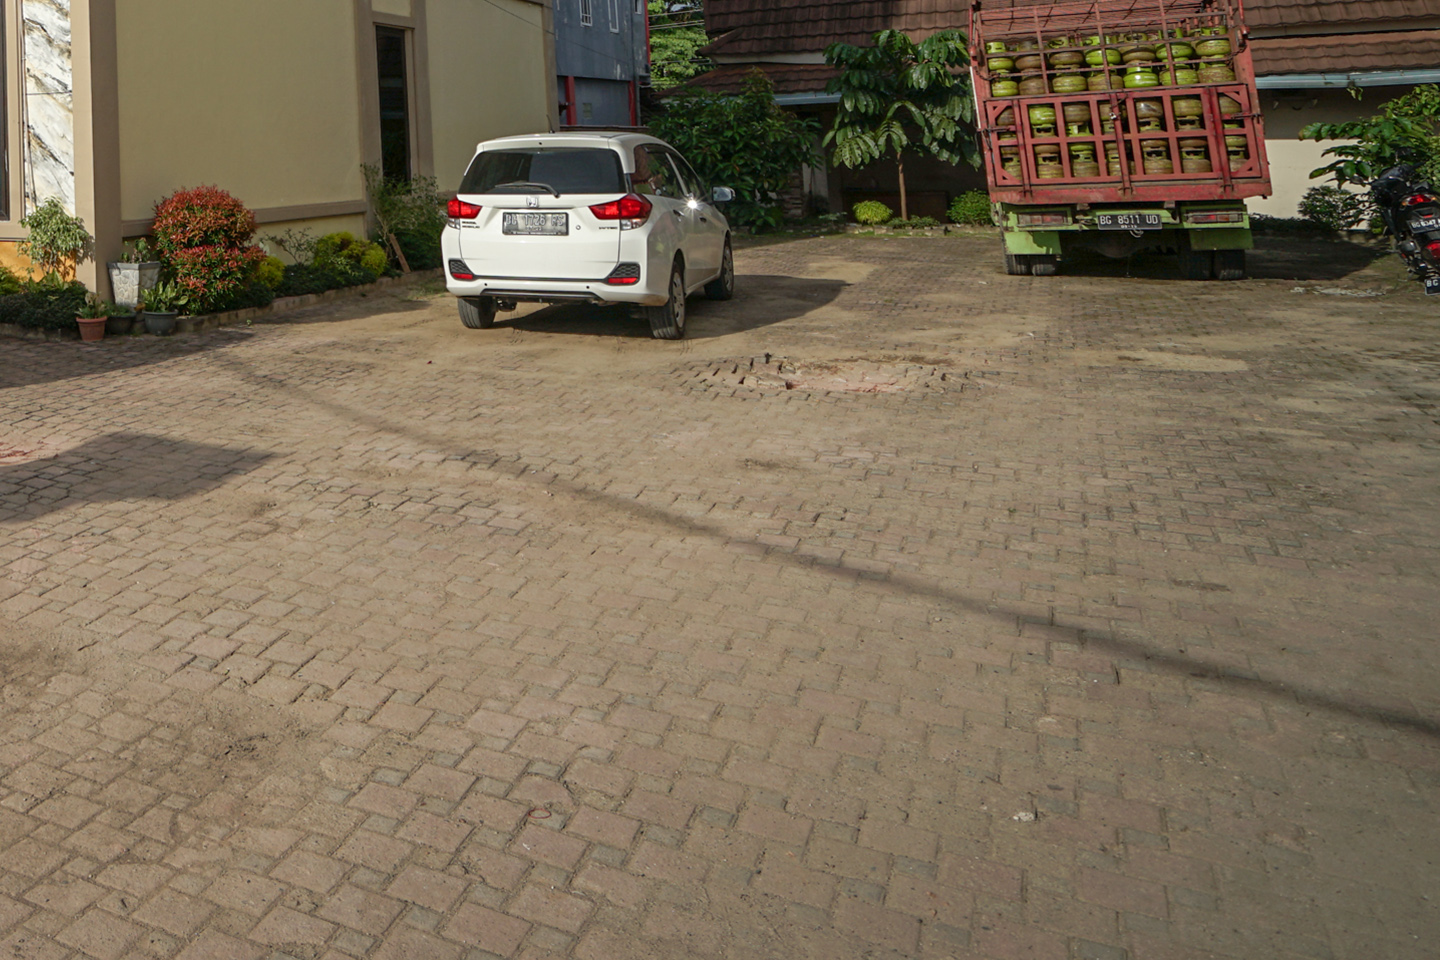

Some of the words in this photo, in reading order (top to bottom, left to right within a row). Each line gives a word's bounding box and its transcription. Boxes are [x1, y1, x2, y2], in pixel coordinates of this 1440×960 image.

[1100, 215, 1112, 225] BG
[1117, 214, 1140, 225] 8511
[1145, 214, 1159, 225] UD
